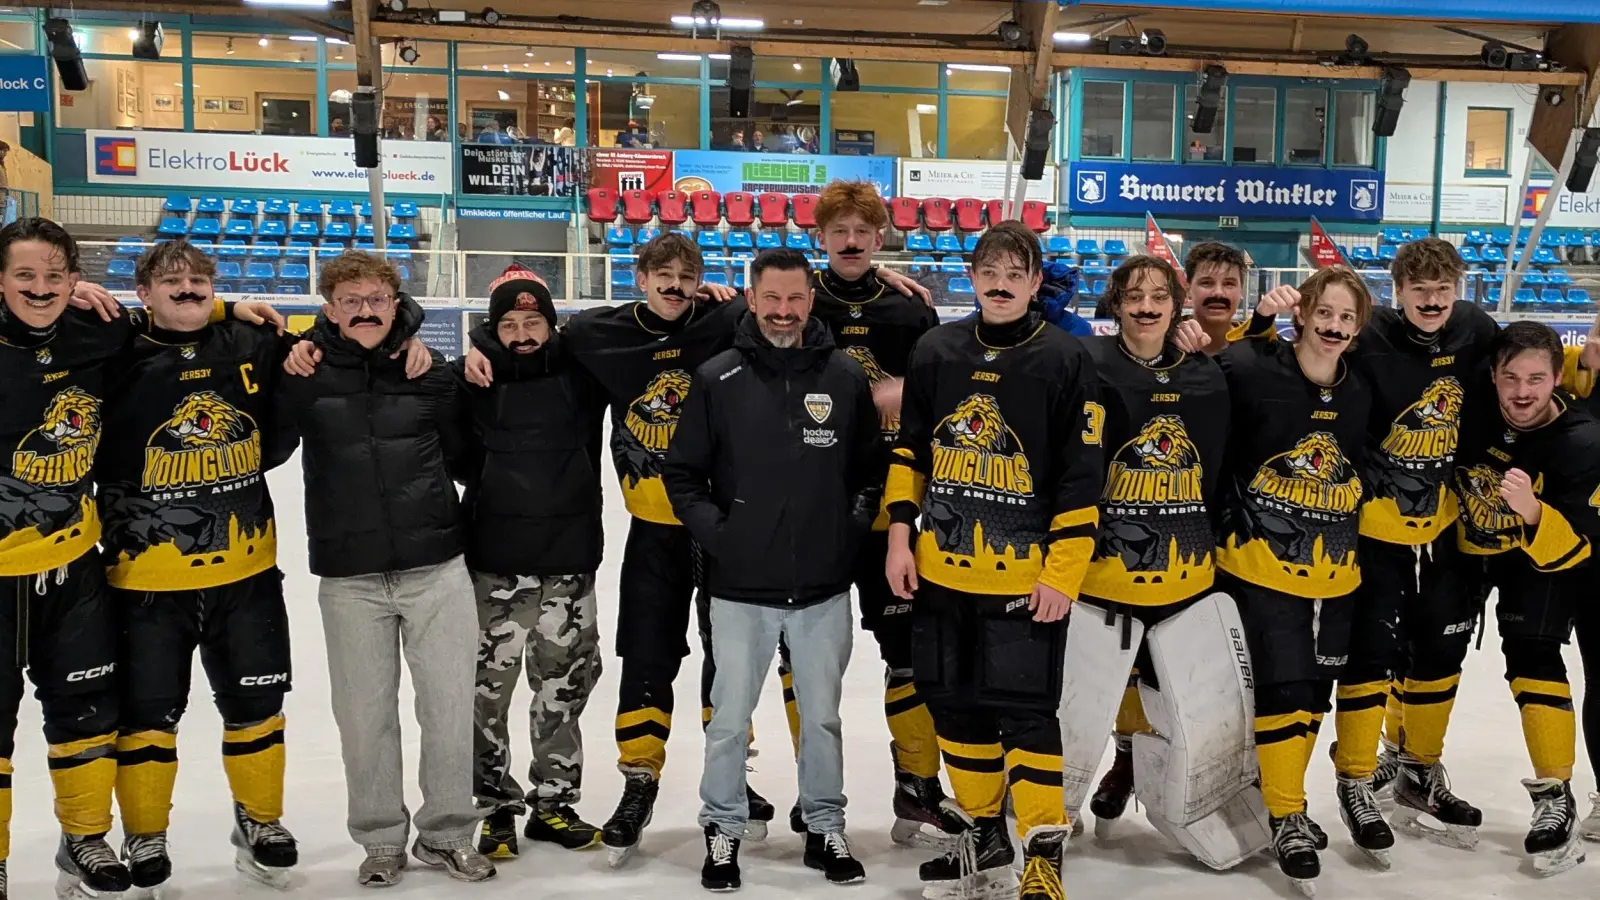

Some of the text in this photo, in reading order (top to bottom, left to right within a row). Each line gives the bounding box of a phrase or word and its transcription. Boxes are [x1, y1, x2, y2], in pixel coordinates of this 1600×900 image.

[0, 77, 45, 89] lock C
[149, 148, 290, 172] ElektroLück
[464, 149, 484, 157] Dein
[312, 169, 435, 181] www.elekolueck.de
[492, 164, 526, 176] DEIN
[468, 174, 514, 186] WILLE.
[1119, 173, 1338, 207] Brauerei Winkler
[1559, 194, 1600, 213] Elekt
[460, 208, 565, 219] Umkleiden öffentlicher Lauf
[239, 363, 259, 394] C
[1082, 401, 1106, 448] 3
[803, 427, 835, 439] hockey
[803, 435, 830, 444] dealer
[932, 446, 1034, 498] OUNGLIONS
[152, 490, 198, 501] ERSC
[963, 490, 1027, 505] AMBERG
[1106, 507, 1149, 516] ERSC
[1256, 498, 1293, 514] ERSC
[1230, 627, 1254, 690] BAUER
[66, 662, 117, 682] CCM
[239, 672, 287, 686] CCM
